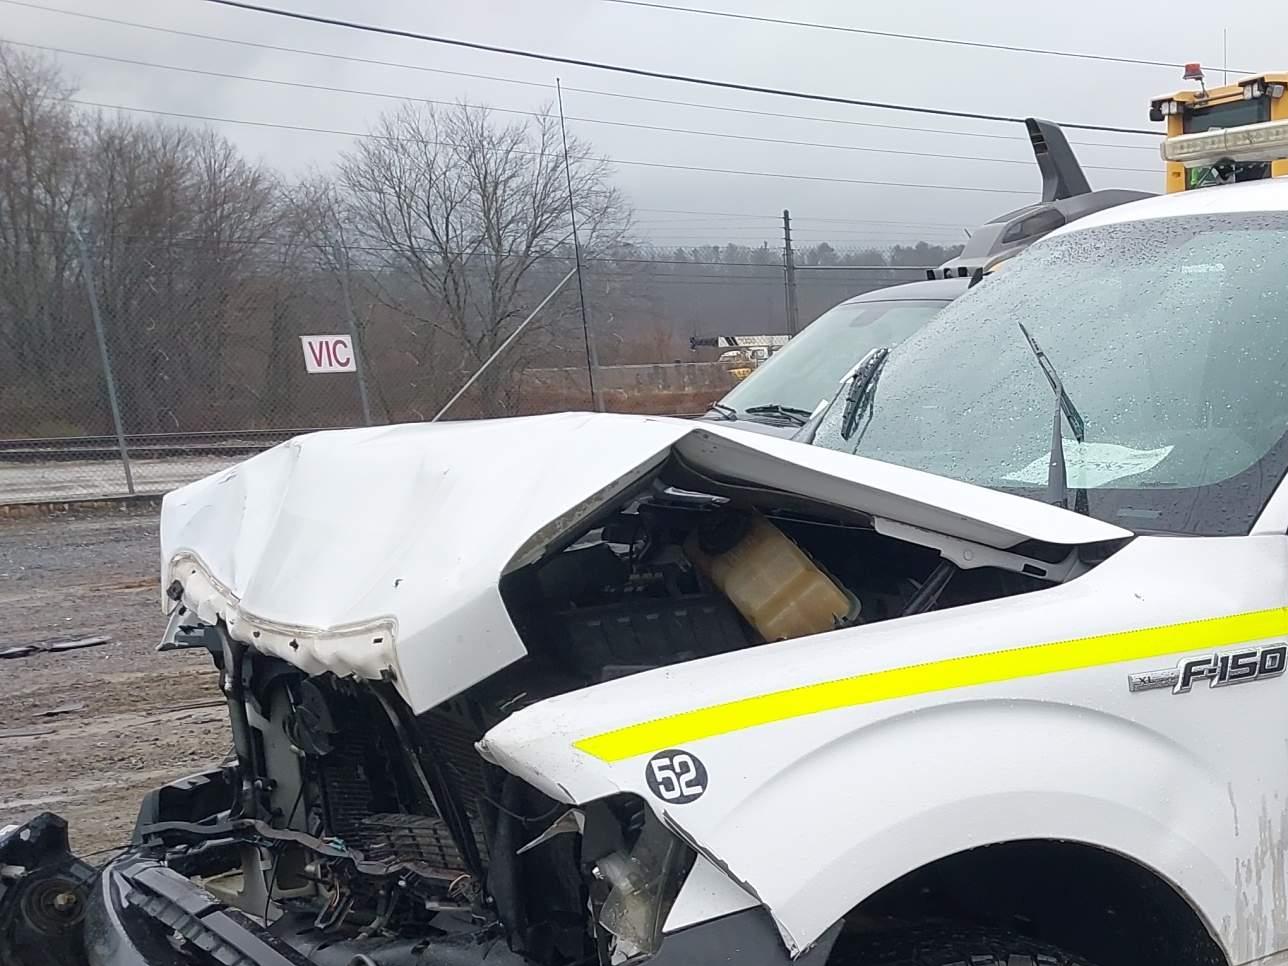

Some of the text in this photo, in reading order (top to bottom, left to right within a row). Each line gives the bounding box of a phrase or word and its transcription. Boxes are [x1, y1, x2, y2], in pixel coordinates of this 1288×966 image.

[308, 339, 351, 368] VIC
[1172, 642, 1288, 695] F-150
[651, 754, 703, 799] 52
